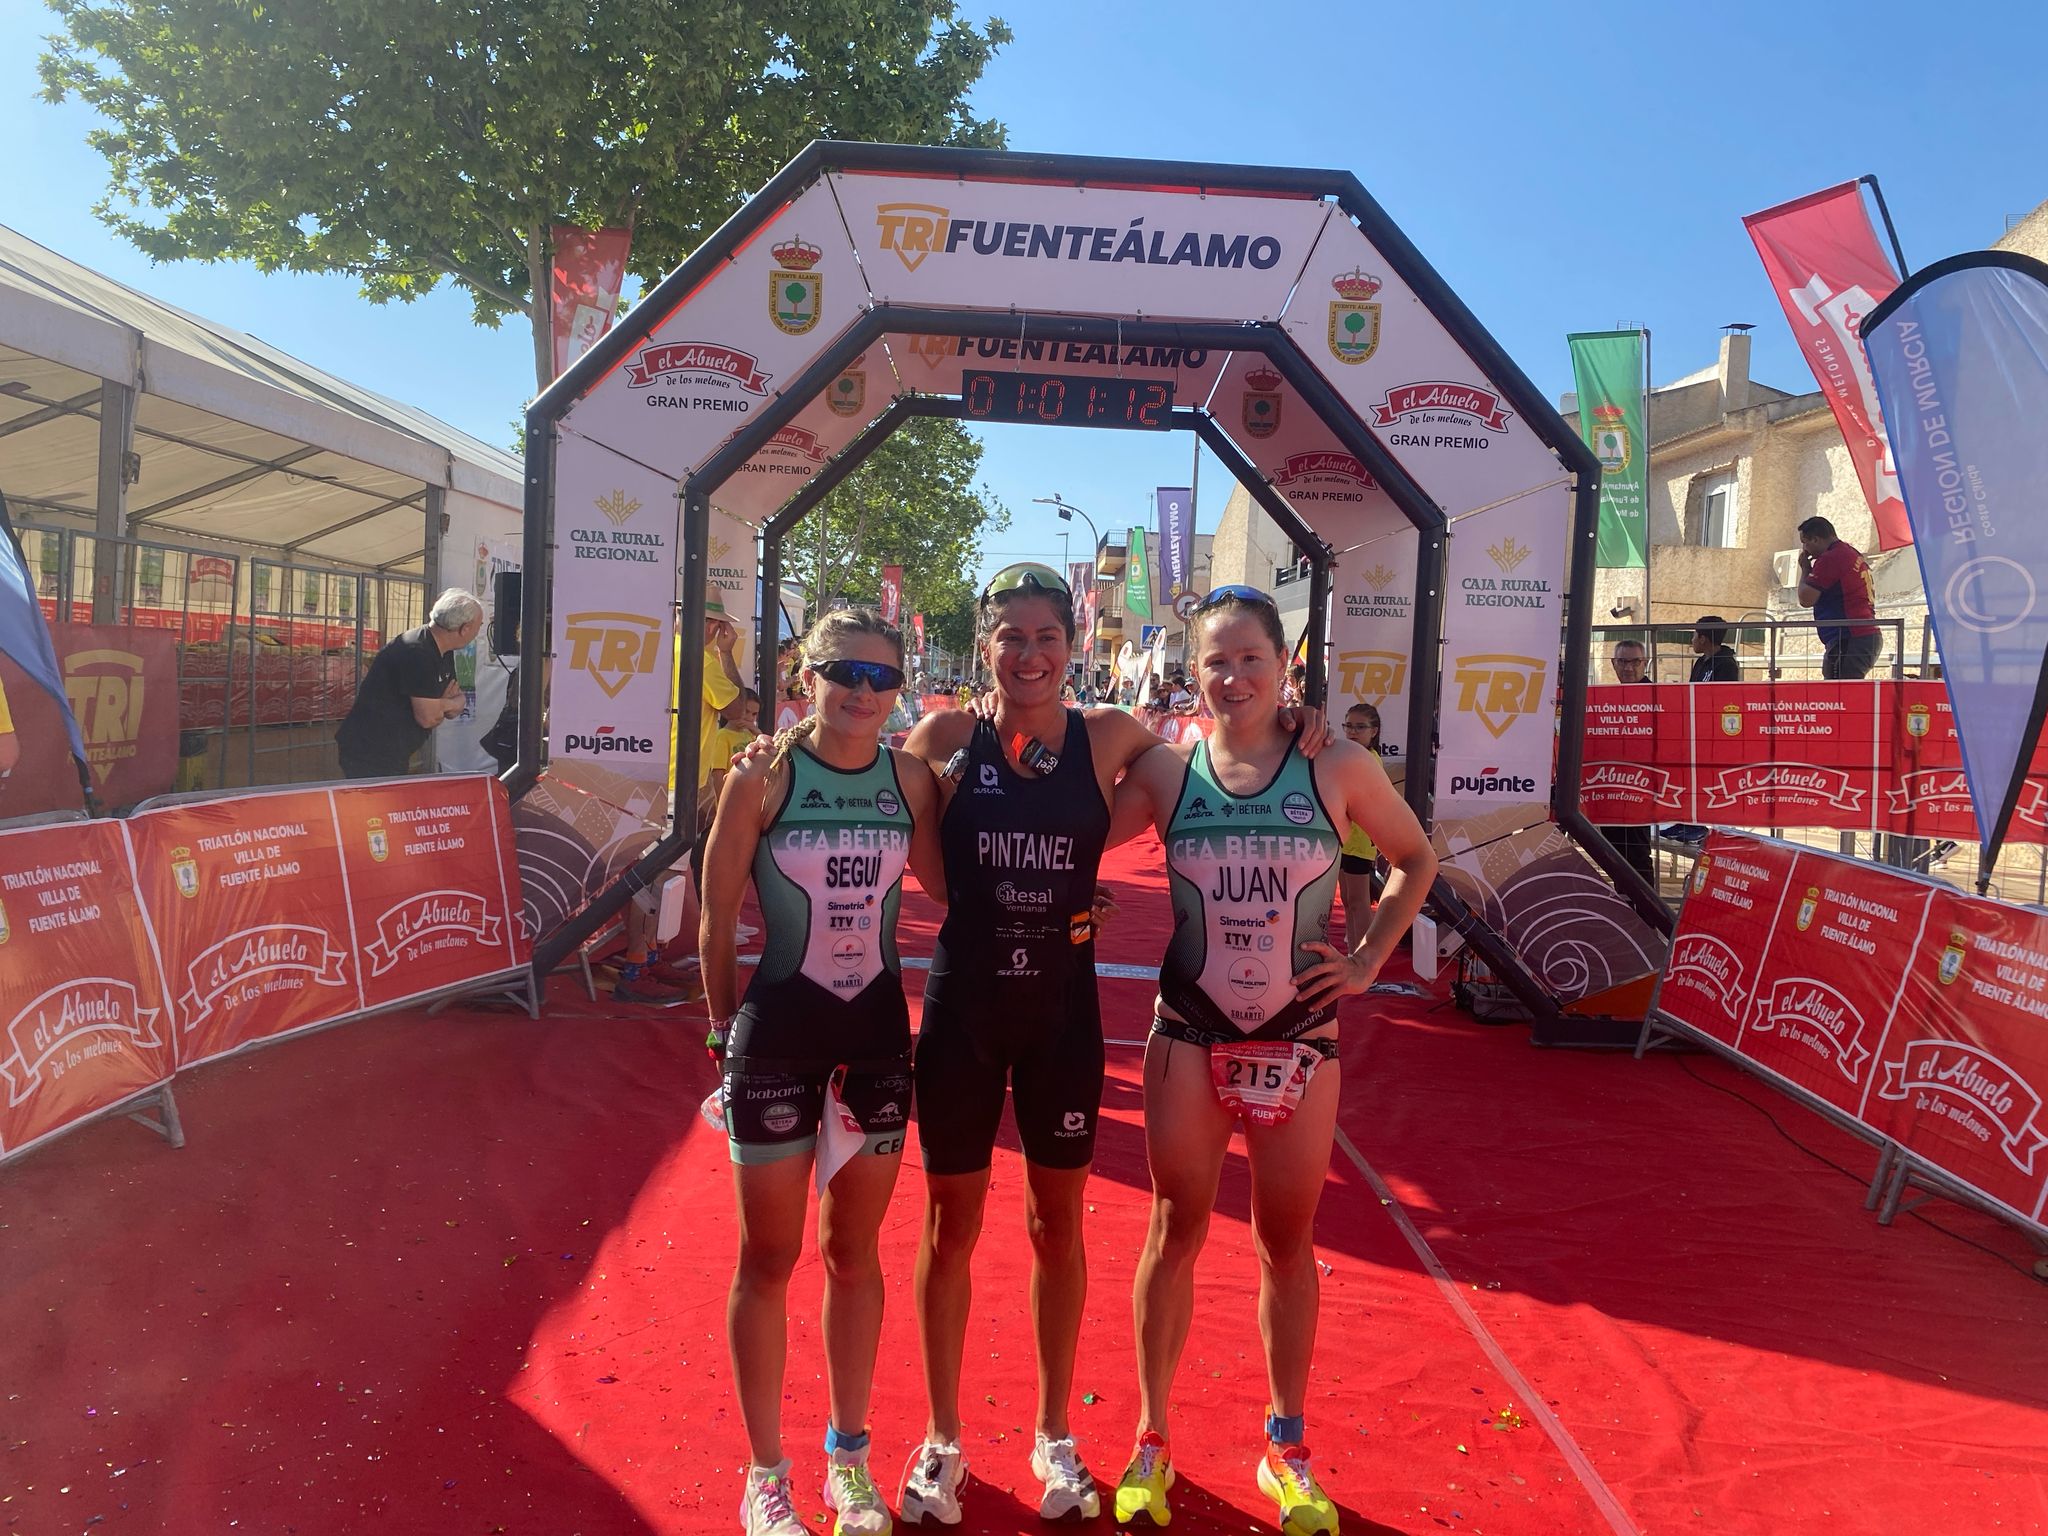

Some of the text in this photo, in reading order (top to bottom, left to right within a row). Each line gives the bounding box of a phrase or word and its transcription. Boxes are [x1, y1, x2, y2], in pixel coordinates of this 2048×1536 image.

[658, 349, 738, 373] el Abuelo
[666, 374, 730, 389] de los melones
[646, 395, 749, 413] GRAN PREMIO
[968, 376, 1167, 426] 01:01:12
[1402, 390, 1481, 411] el Abuelo
[1410, 413, 1473, 427] de los melones
[1390, 434, 1489, 450] GRAN PREMIO
[769, 465, 811, 475] PREMIO
[1298, 456, 1357, 473] el Abuelo
[1288, 490, 1363, 503] GRAN PREMIO
[570, 529, 664, 547] CAJA RURAL
[574, 547, 659, 563] REGIONAL
[708, 567, 748, 578] RURAL
[1461, 577, 1551, 592] CAJA RURAL
[1343, 594, 1411, 606] CAJA RURAL
[1465, 594, 1545, 609] REGIONAL
[1346, 607, 1407, 618] REGIONAL
[565, 626, 662, 674] TRI
[1338, 662, 1407, 695] TRI
[1454, 670, 1546, 714] TRI
[1585, 702, 1664, 713] IATLÓN NACIONAL
[1746, 700, 1847, 712] TRIATLÓN NACIONAL
[1600, 715, 1639, 724] VILLA DE
[1774, 714, 1817, 723] VILLA DE
[1587, 724, 1653, 736] FUENTE ÁLAMO
[1759, 724, 1833, 736] FUENTE ÁLAMO
[565, 734, 653, 755] pujante
[1450, 775, 1536, 796] pujante
[1585, 766, 1650, 788] Abuelo
[1738, 767, 1827, 790] el Abuelo
[1591, 791, 1605, 801] los
[1607, 792, 1645, 804] melones
[1747, 793, 1820, 807] de los melones
[388, 805, 471, 824] TRIATLÓN NACIONAL
[1238, 803, 1272, 815] BÉTERA
[198, 823, 308, 853] TRIATLÓN NACIONAL
[415, 823, 451, 837] VILLA DE
[786, 823, 909, 852] CEA BÉTERA
[234, 845, 281, 865] VILLA DE
[404, 836, 465, 856] FUENTE ÁLAMO
[978, 831, 1075, 871] PINTANEL
[1173, 829, 1327, 861] CEA BÉTERA
[1, 859, 102, 891] TRIATLÓN NACIONAL
[220, 860, 301, 888] FUENTE ÁLAMO
[826, 849, 882, 889] SEGUÍ
[1714, 856, 1771, 882] TRIATLÓN NACIONAL
[1212, 866, 1288, 903] JUAN
[1724, 874, 1750, 891] VILLA DE
[38, 886, 82, 907] VILLA DE
[828, 901, 865, 911] Simetria
[1711, 887, 1754, 911] FUENTE ÁLAMO
[1823, 887, 1899, 923] TRIATLÓN NACIONAL
[29, 904, 100, 934] FUENTE ÁLAMO
[1006, 904, 1047, 913] ventanas
[396, 899, 470, 940] el Abuelo
[830, 916, 854, 928] ITV
[1220, 915, 1266, 928] Simetria
[1838, 912, 1870, 933] VILLA DE
[407, 935, 469, 962] de los melones
[1224, 932, 1252, 947] ITV
[1820, 925, 1877, 956] FUENTE ÁLAMO
[1974, 934, 2026, 962] TRIATLÓN
[211, 935, 307, 987] el Abuelo
[1691, 943, 1729, 981] Abuelo
[1996, 963, 2046, 992] VILLA DE
[223, 976, 304, 1011] de los melones
[1696, 980, 1718, 1001] melones
[1972, 979, 2014, 1005] FUENTE
[33, 988, 120, 1052] el Abuelo
[1781, 987, 1845, 1036] el Abuelo
[1780, 1022, 1831, 1060] de los melones
[51, 1040, 123, 1081] de los melones
[1225, 1060, 1283, 1090] 215
[1918, 1051, 2013, 1116] el Abuelo
[746, 1085, 805, 1100] babaria
[1916, 1092, 1992, 1142] de los melones
